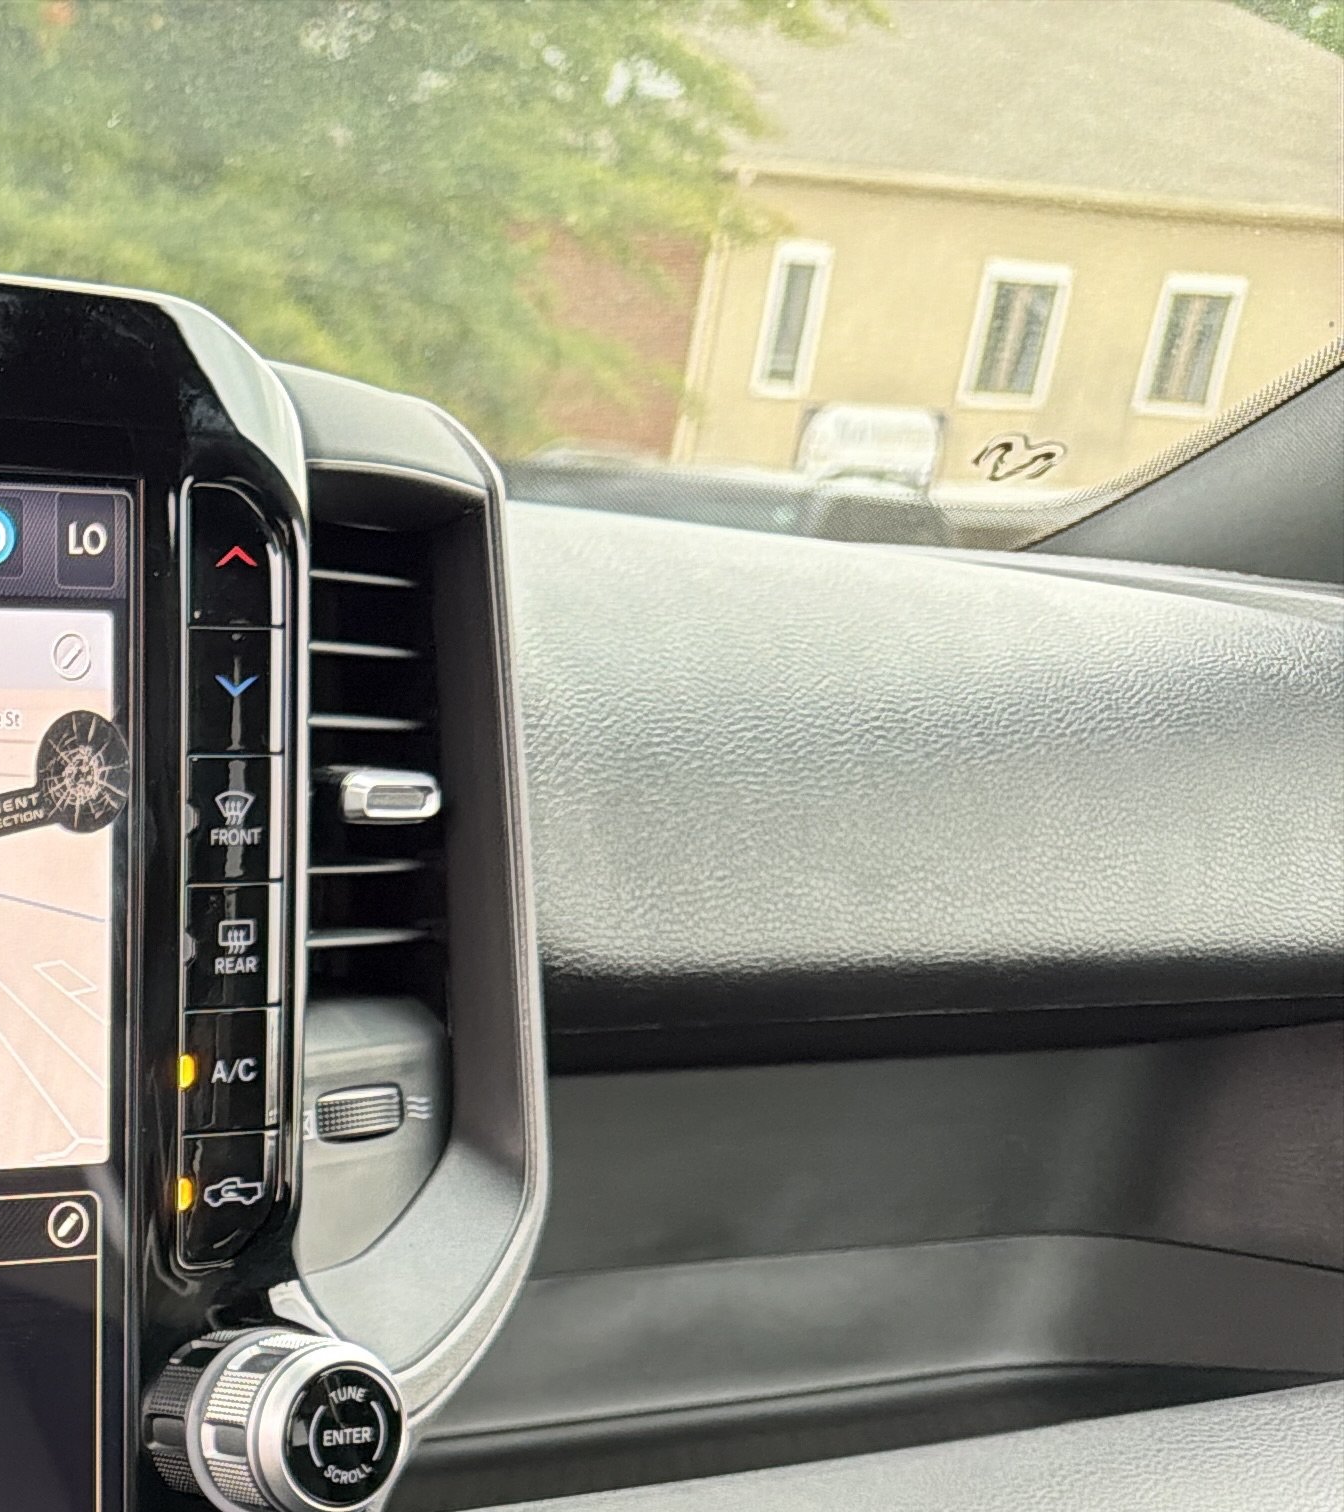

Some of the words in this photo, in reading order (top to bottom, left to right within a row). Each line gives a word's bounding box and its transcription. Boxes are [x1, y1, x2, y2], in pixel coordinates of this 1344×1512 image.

[67, 521, 109, 556] LO
[6, 711, 21, 727] St
[210, 828, 262, 846] FRONT
[214, 957, 257, 974] REAR
[212, 1057, 257, 1083] A/C
[328, 1386, 367, 1404] TUNE
[323, 1428, 373, 1446] ENTER
[323, 1464, 372, 1485] SCROLL
